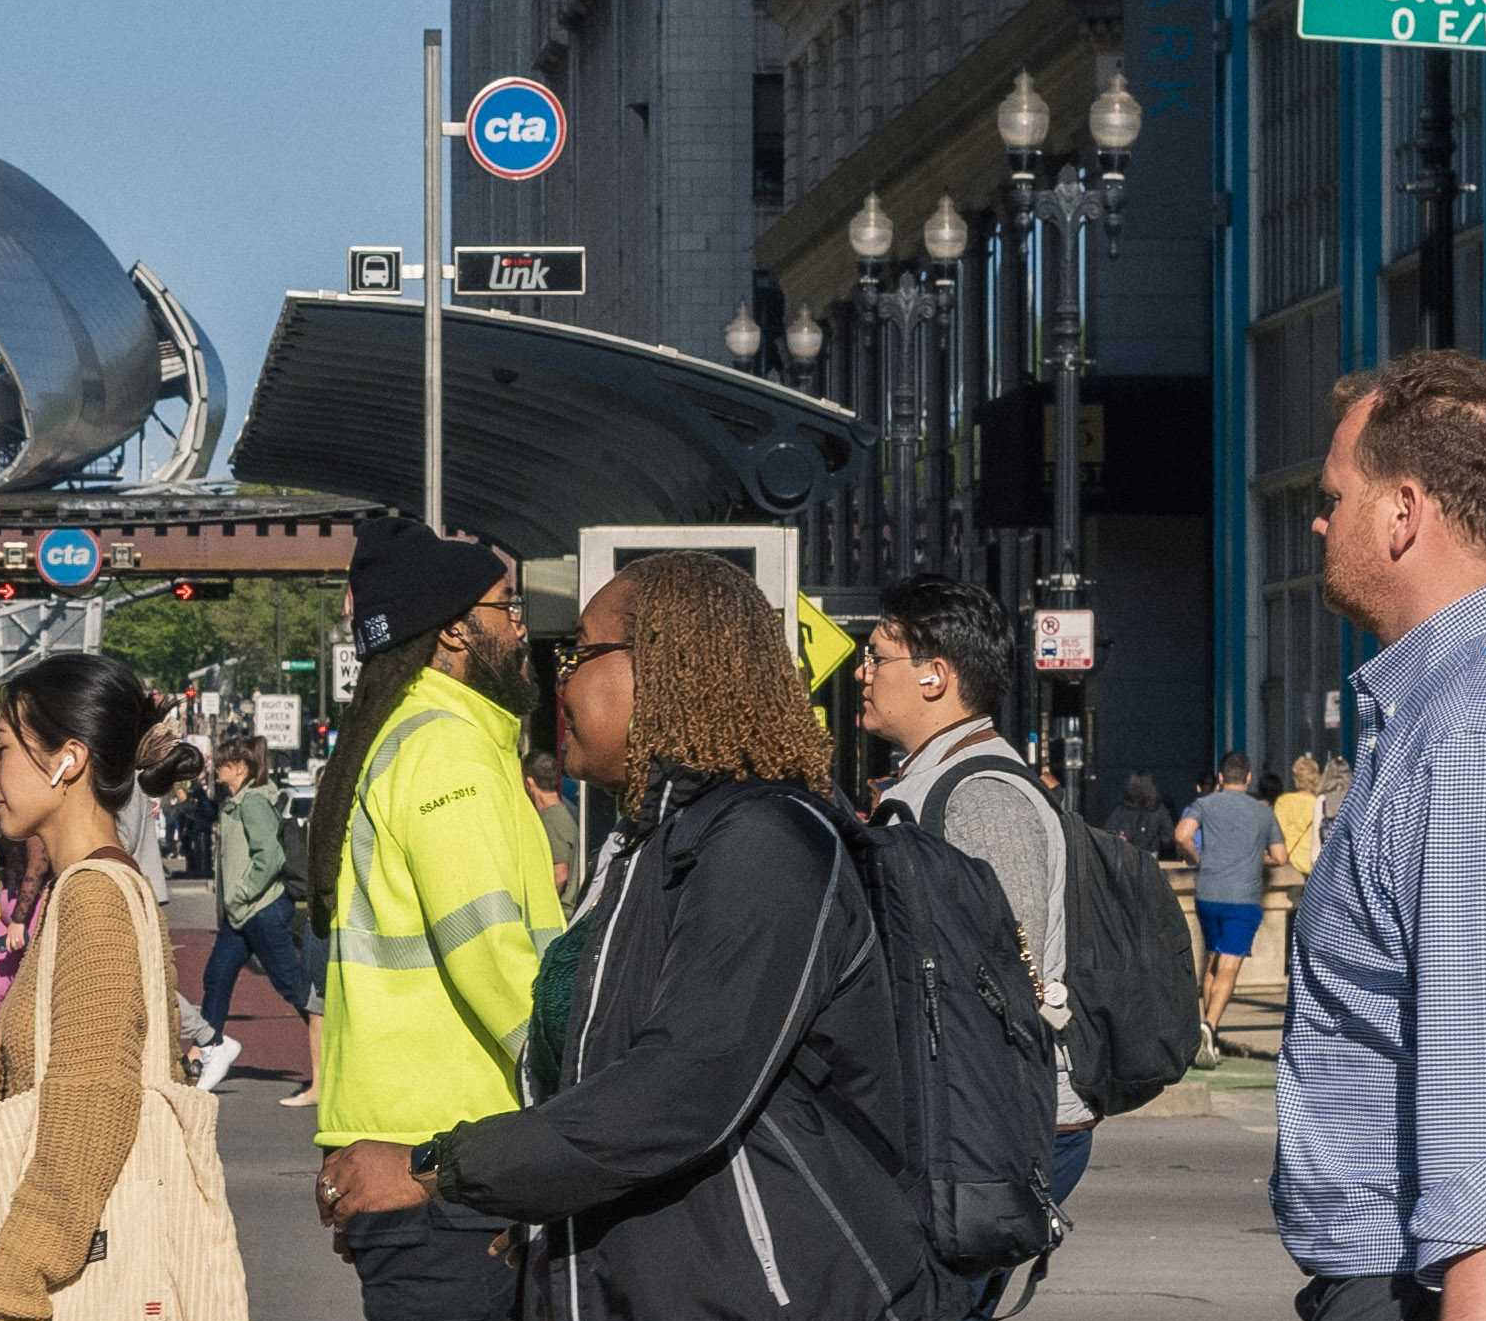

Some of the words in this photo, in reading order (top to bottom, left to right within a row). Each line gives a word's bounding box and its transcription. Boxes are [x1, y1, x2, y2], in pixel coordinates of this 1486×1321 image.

[484, 112, 547, 143] cta
[46, 544, 91, 565] cta
[1061, 639, 1080, 648] BUS
[1062, 648, 1085, 658] STOP
[261, 701, 281, 710] RIGHT
[284, 701, 294, 710] ON
[264, 712, 290, 721] GREEN
[264, 723, 291, 731] ARROW
[419, 786, 477, 815] SSA#1-2015
